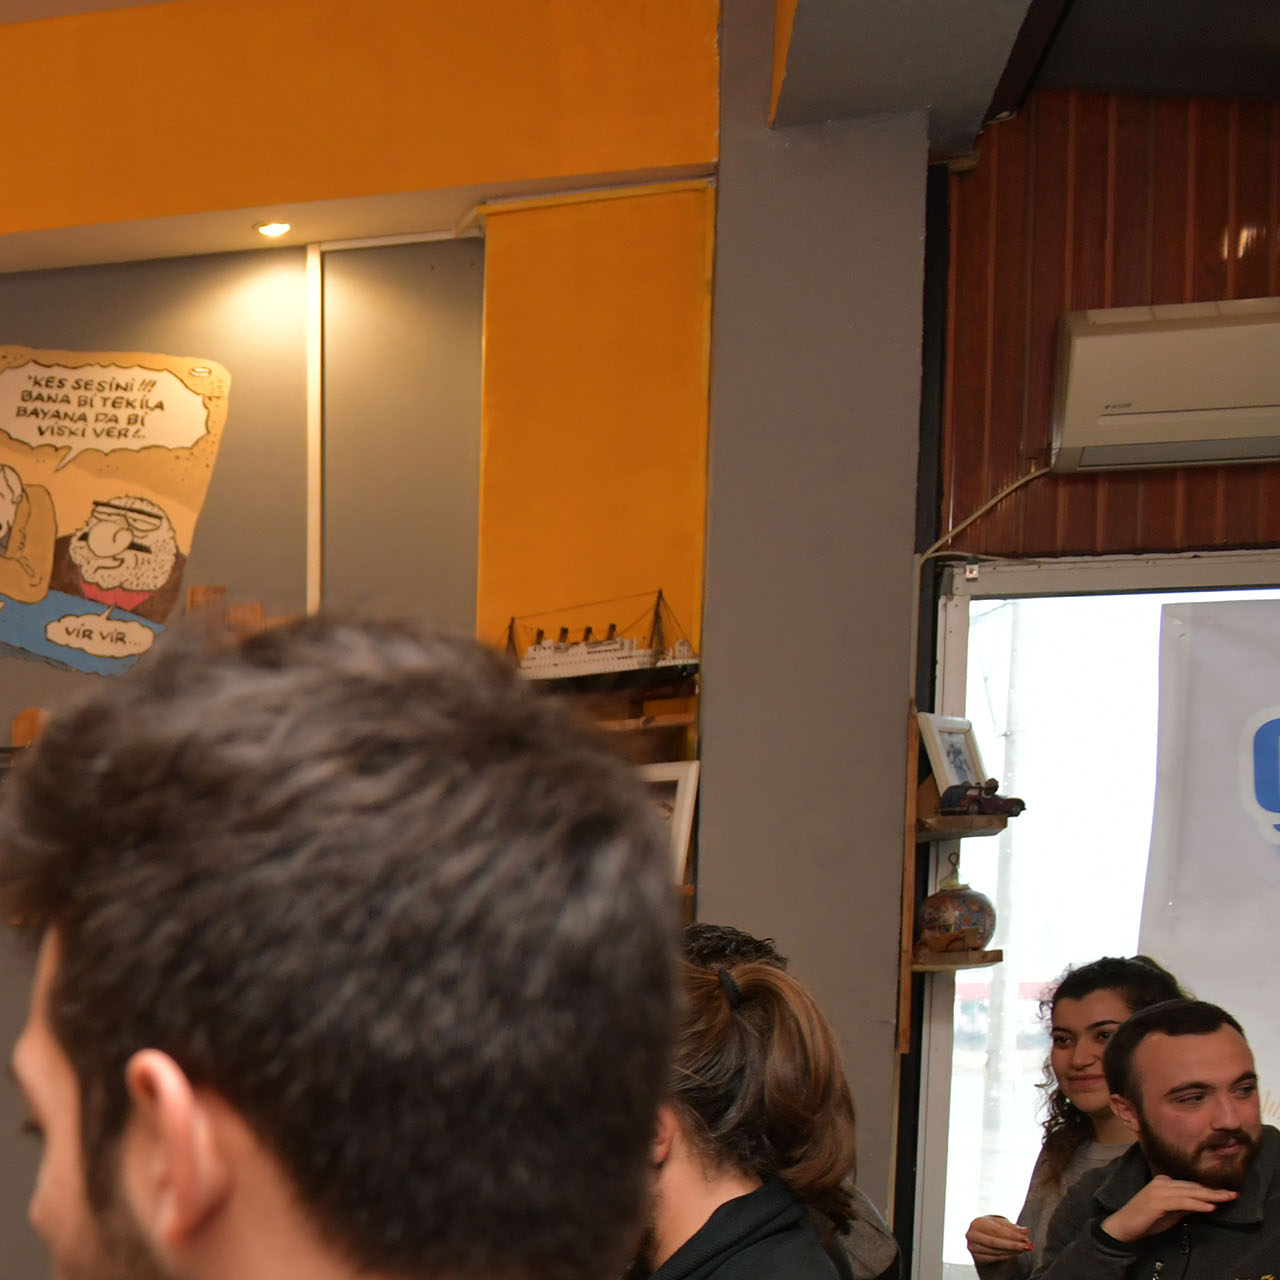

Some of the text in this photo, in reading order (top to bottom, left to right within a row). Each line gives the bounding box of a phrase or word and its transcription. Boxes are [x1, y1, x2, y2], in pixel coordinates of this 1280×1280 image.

[72, 377, 135, 392] SESİNİ
[20, 389, 71, 404] BANA
[101, 393, 165, 411] TEKİLA
[15, 406, 88, 423] BAYANA
[37, 421, 88, 438] VİSKİ
[64, 622, 94, 640] VİR
